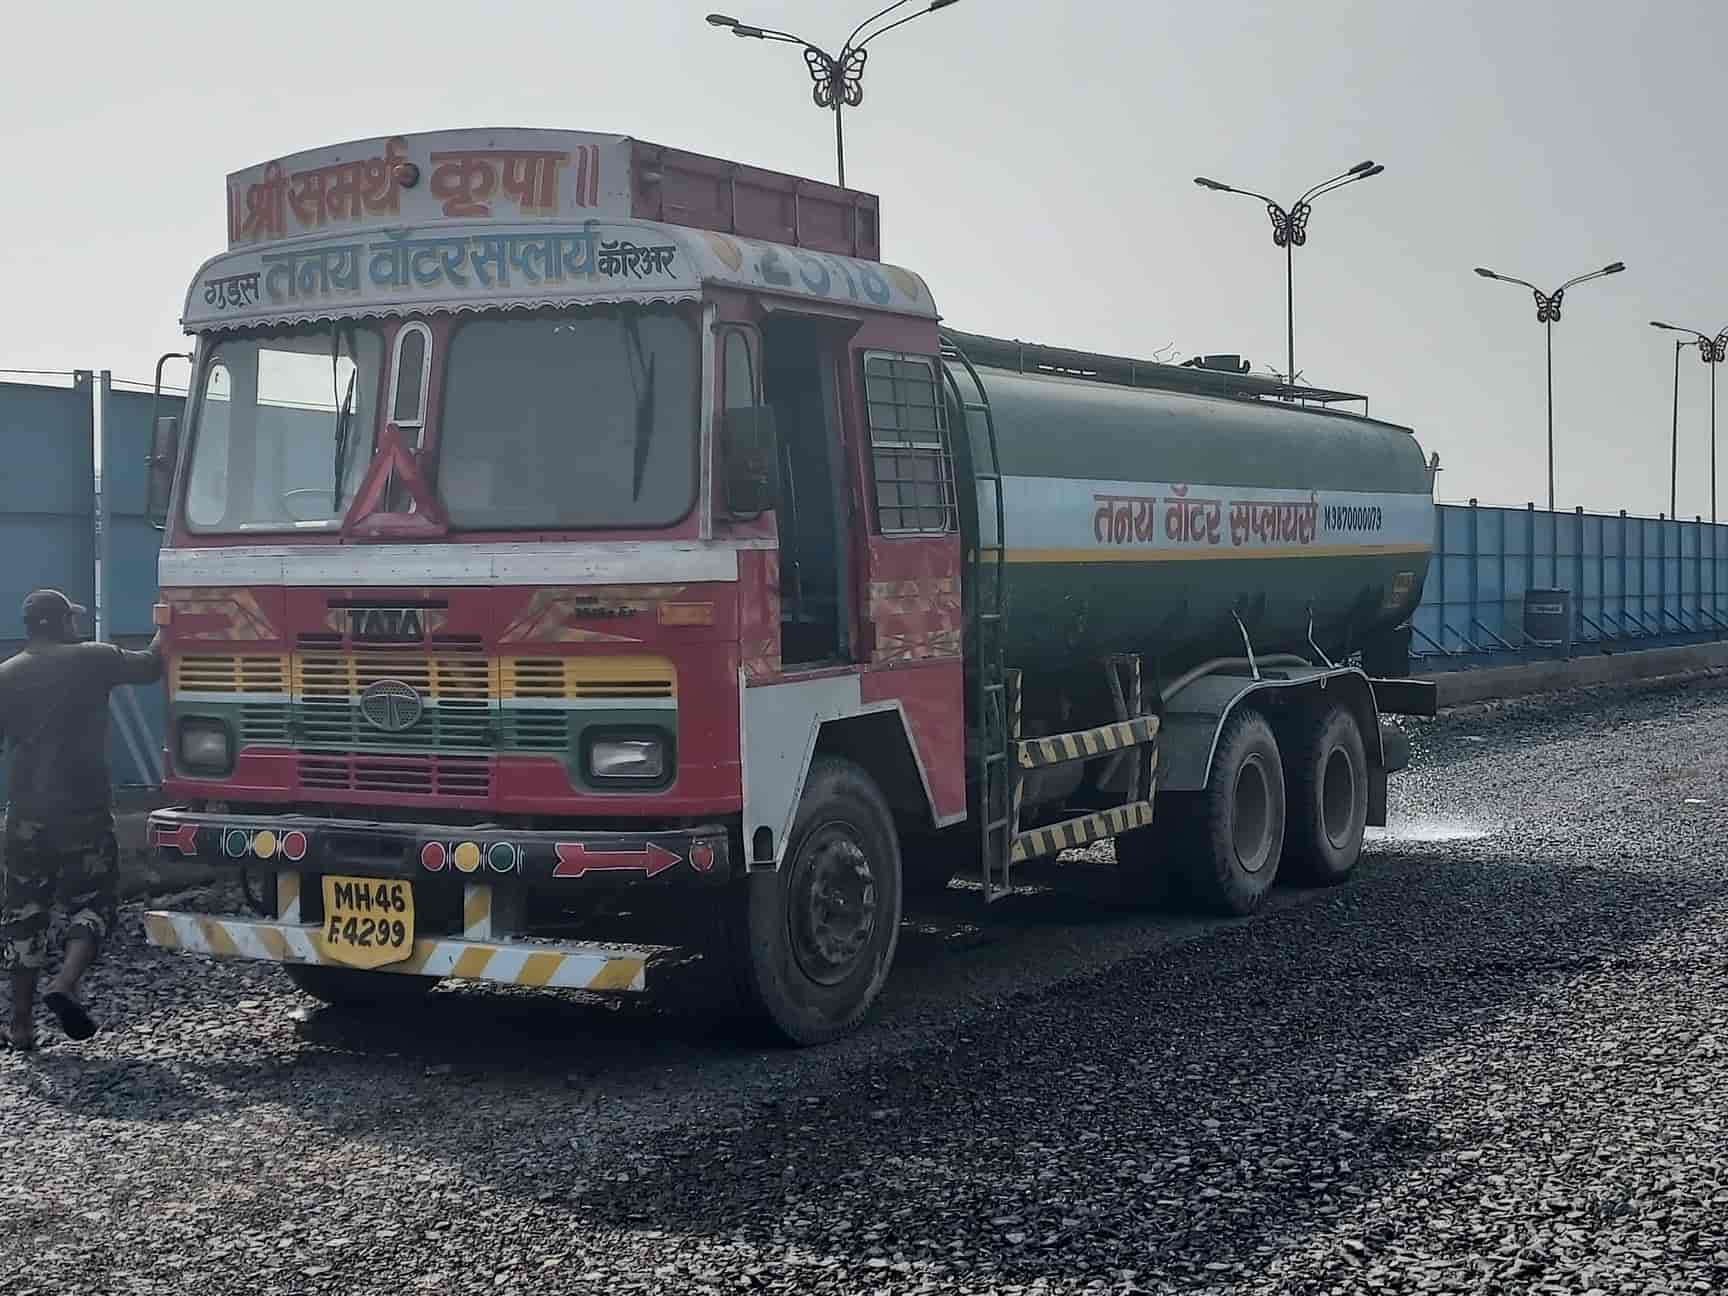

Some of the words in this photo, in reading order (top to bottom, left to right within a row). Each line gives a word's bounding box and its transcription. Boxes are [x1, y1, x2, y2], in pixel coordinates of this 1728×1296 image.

[430, 150, 572, 217] कृपा
[262, 243, 366, 300] तनय
[1094, 494, 1156, 544] तनय
[1164, 483, 1222, 545] वॉटर
[349, 608, 423, 636] TATA
